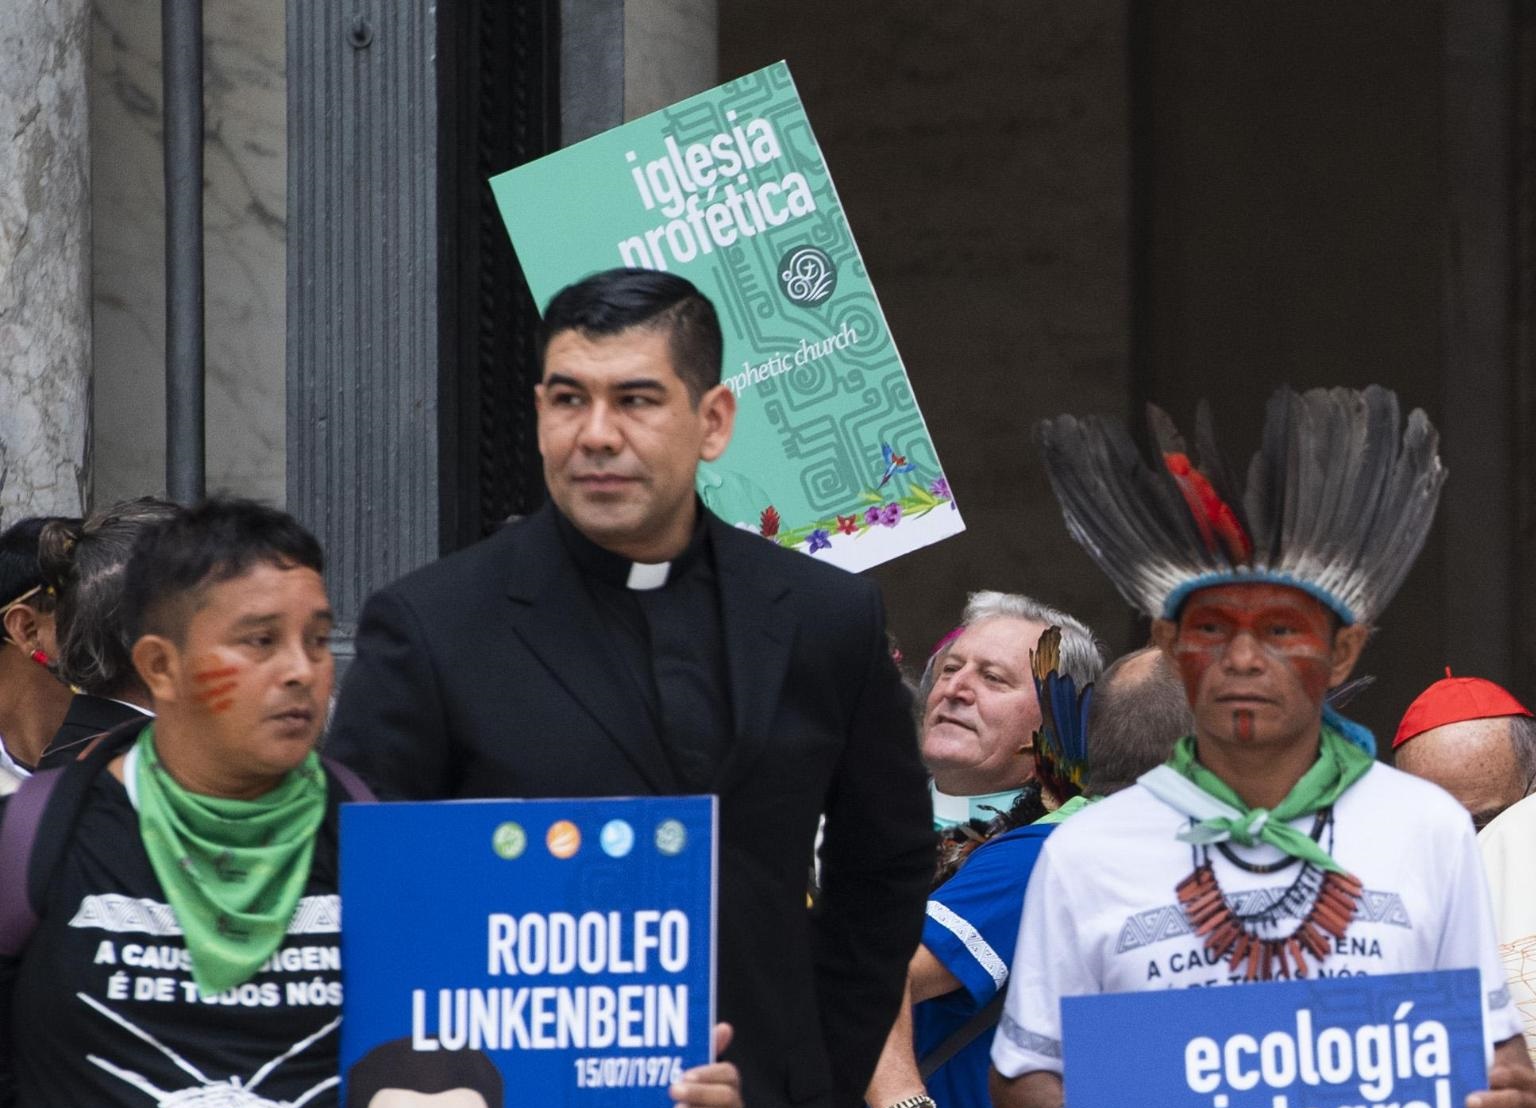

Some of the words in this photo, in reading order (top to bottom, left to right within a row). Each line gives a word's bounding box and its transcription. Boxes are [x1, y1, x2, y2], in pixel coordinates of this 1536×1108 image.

[625, 110, 781, 219] iglesia
[721, 352, 793, 398] ophetic
[794, 322, 858, 367] church
[94, 940, 117, 964] A
[122, 944, 194, 972] CAUS
[487, 909, 690, 976] RODOLFO
[1147, 960, 1161, 981] A
[1169, 945, 1232, 973] CAU
[107, 971, 129, 1000] É
[135, 976, 176, 1002] DE
[412, 984, 689, 1052] LUNKENBEIN
[1184, 1001, 1452, 1101] ecología
